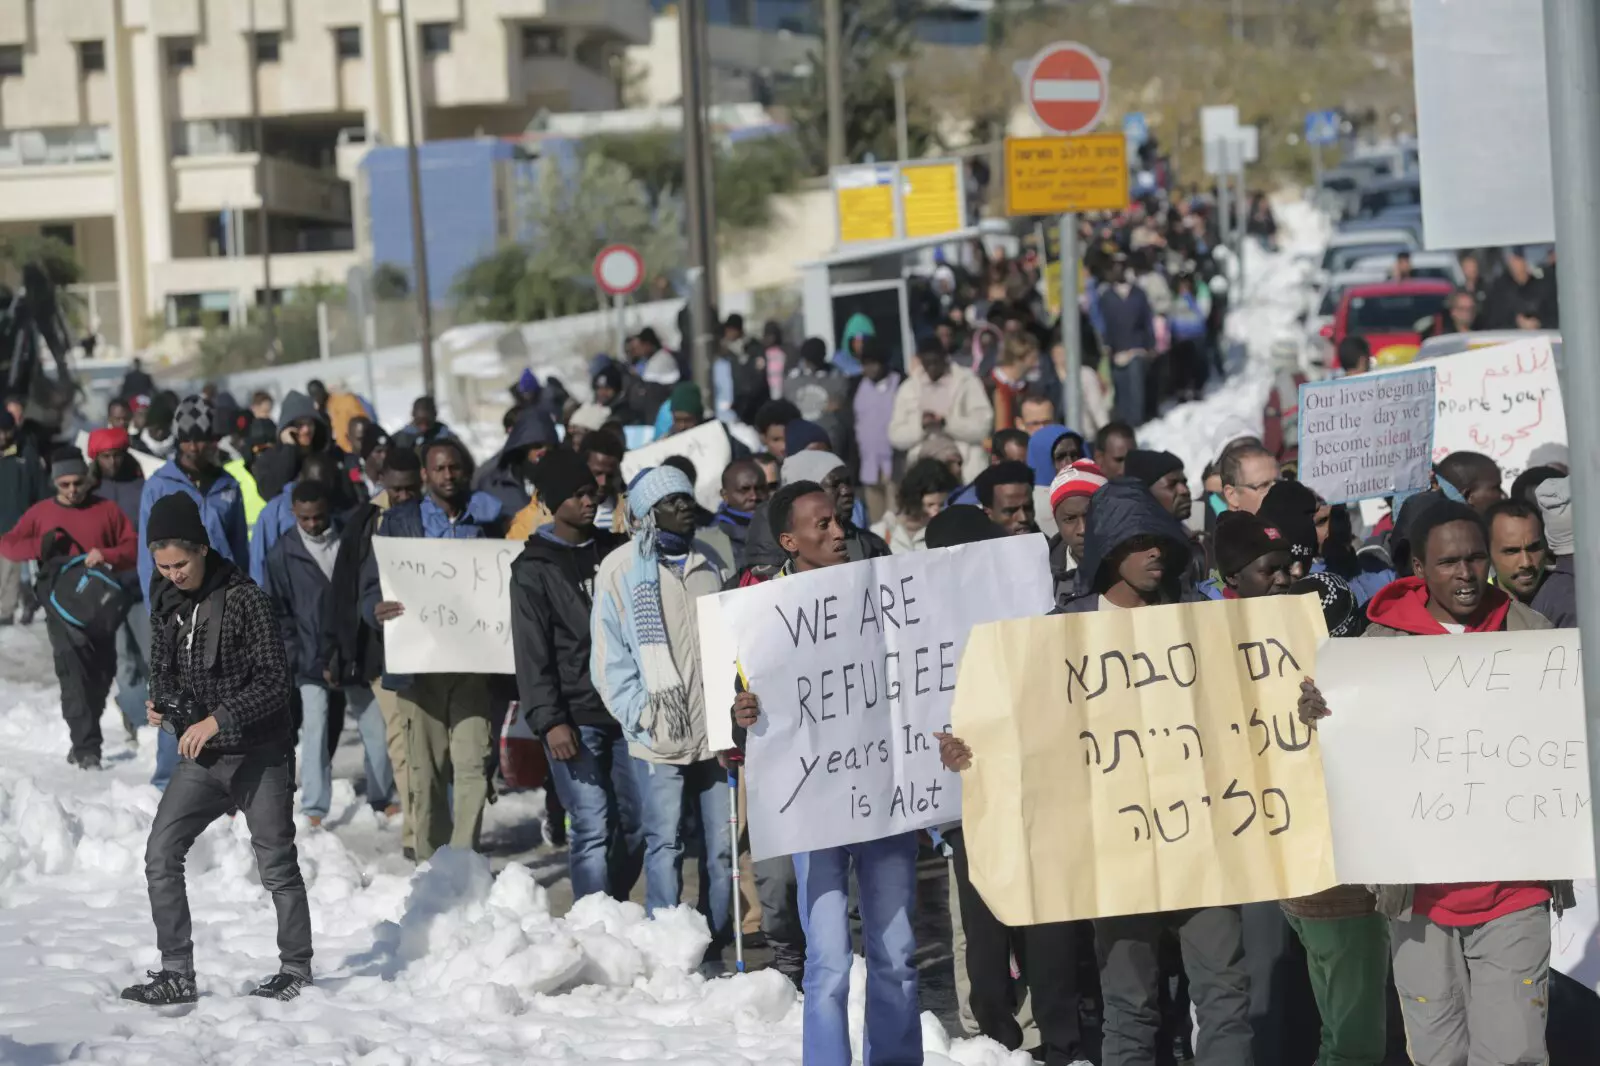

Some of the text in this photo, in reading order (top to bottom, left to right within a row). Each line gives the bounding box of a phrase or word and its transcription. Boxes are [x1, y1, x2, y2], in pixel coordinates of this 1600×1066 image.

[1306, 393, 1335, 410] Our
[1340, 388, 1374, 405] lives
[1376, 382, 1413, 402] begin
[1418, 380, 1429, 394] to
[1308, 405, 1420, 434] end the day we
[1312, 458, 1353, 478] about
[1361, 452, 1401, 469] things
[1405, 442, 1428, 460] that
[1315, 429, 1411, 457] become silent
[775, 575, 921, 648] WE ARE
[1065, 638, 1301, 704] גם סבתא
[1423, 648, 1512, 692] WE
[1079, 708, 1312, 774] שלי הייתה
[780, 738, 889, 814] years
[902, 724, 930, 755] In
[851, 779, 943, 819] is Alot
[1118, 778, 1291, 843] פליטה
